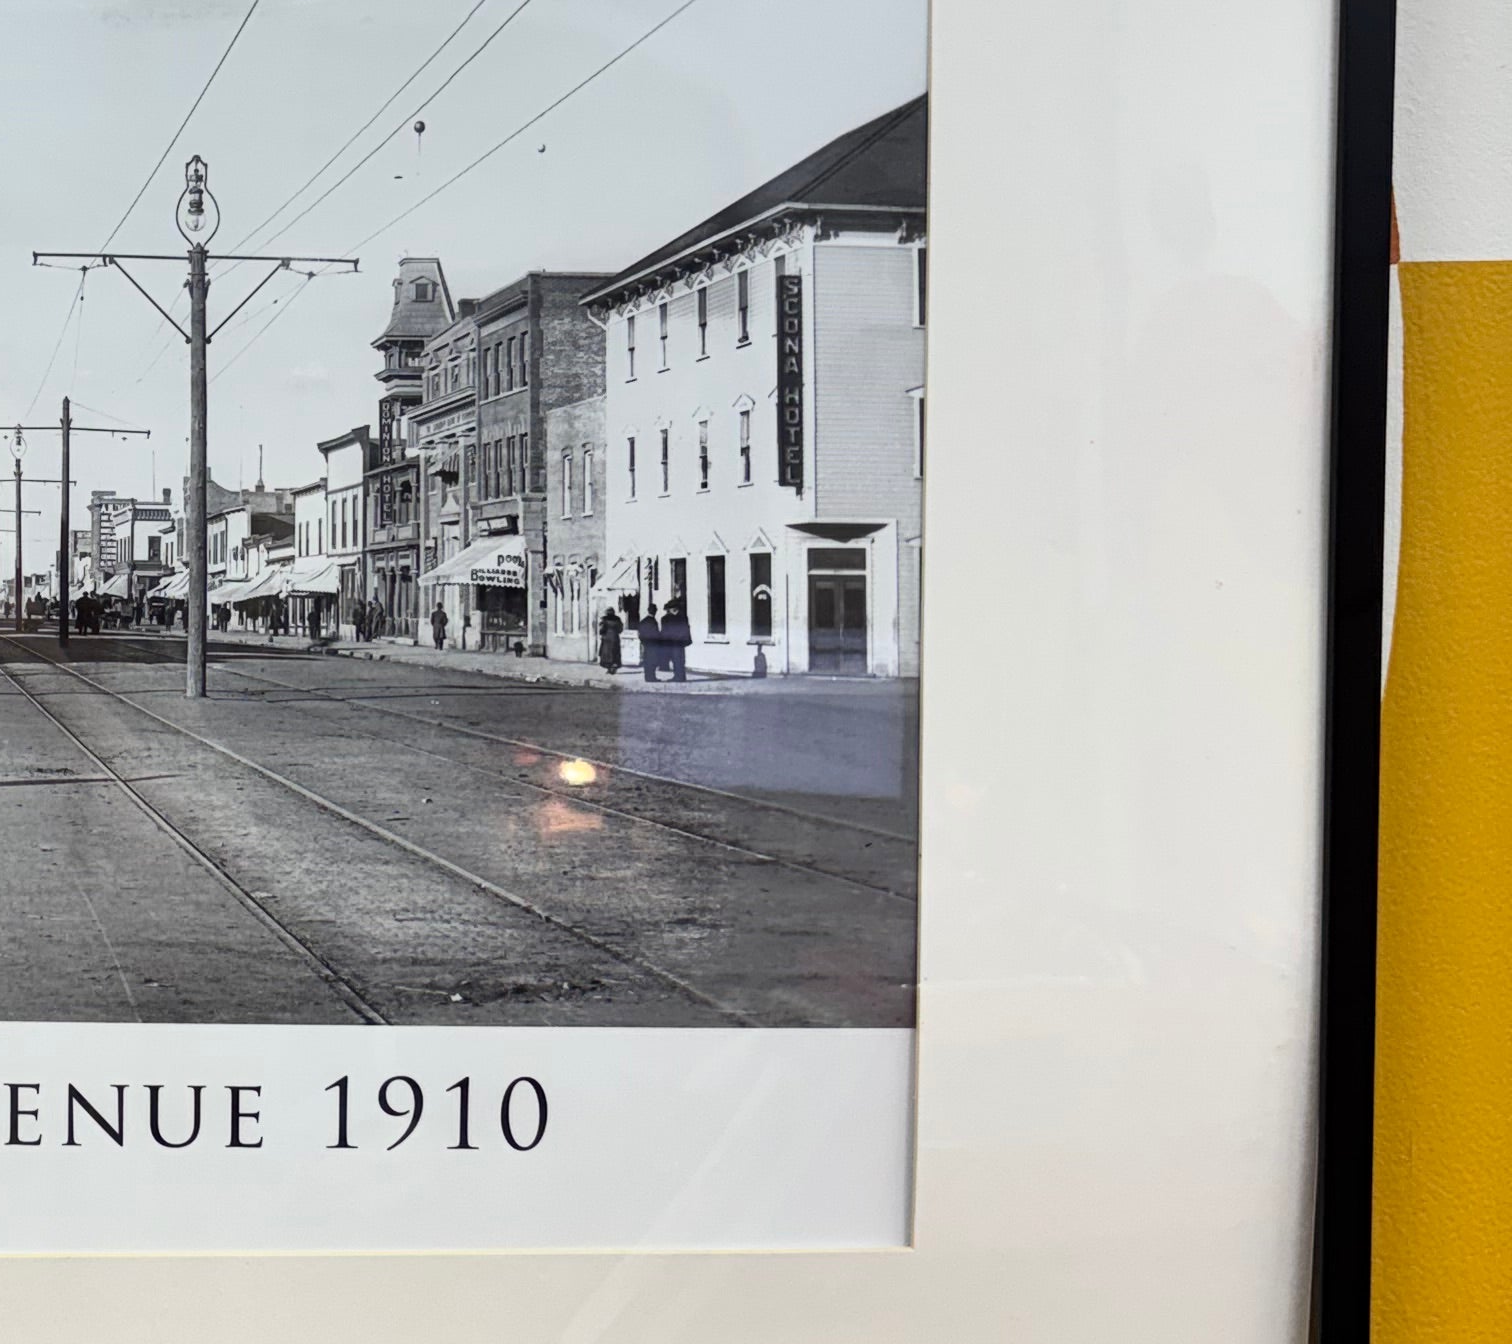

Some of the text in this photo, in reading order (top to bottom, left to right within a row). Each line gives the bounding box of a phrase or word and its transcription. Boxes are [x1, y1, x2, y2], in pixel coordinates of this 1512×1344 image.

[784, 278, 800, 484] SCONA HOTEL
[382, 402, 391, 521] DOMINION HOTEL
[325, 1076, 548, 1151] 1910
